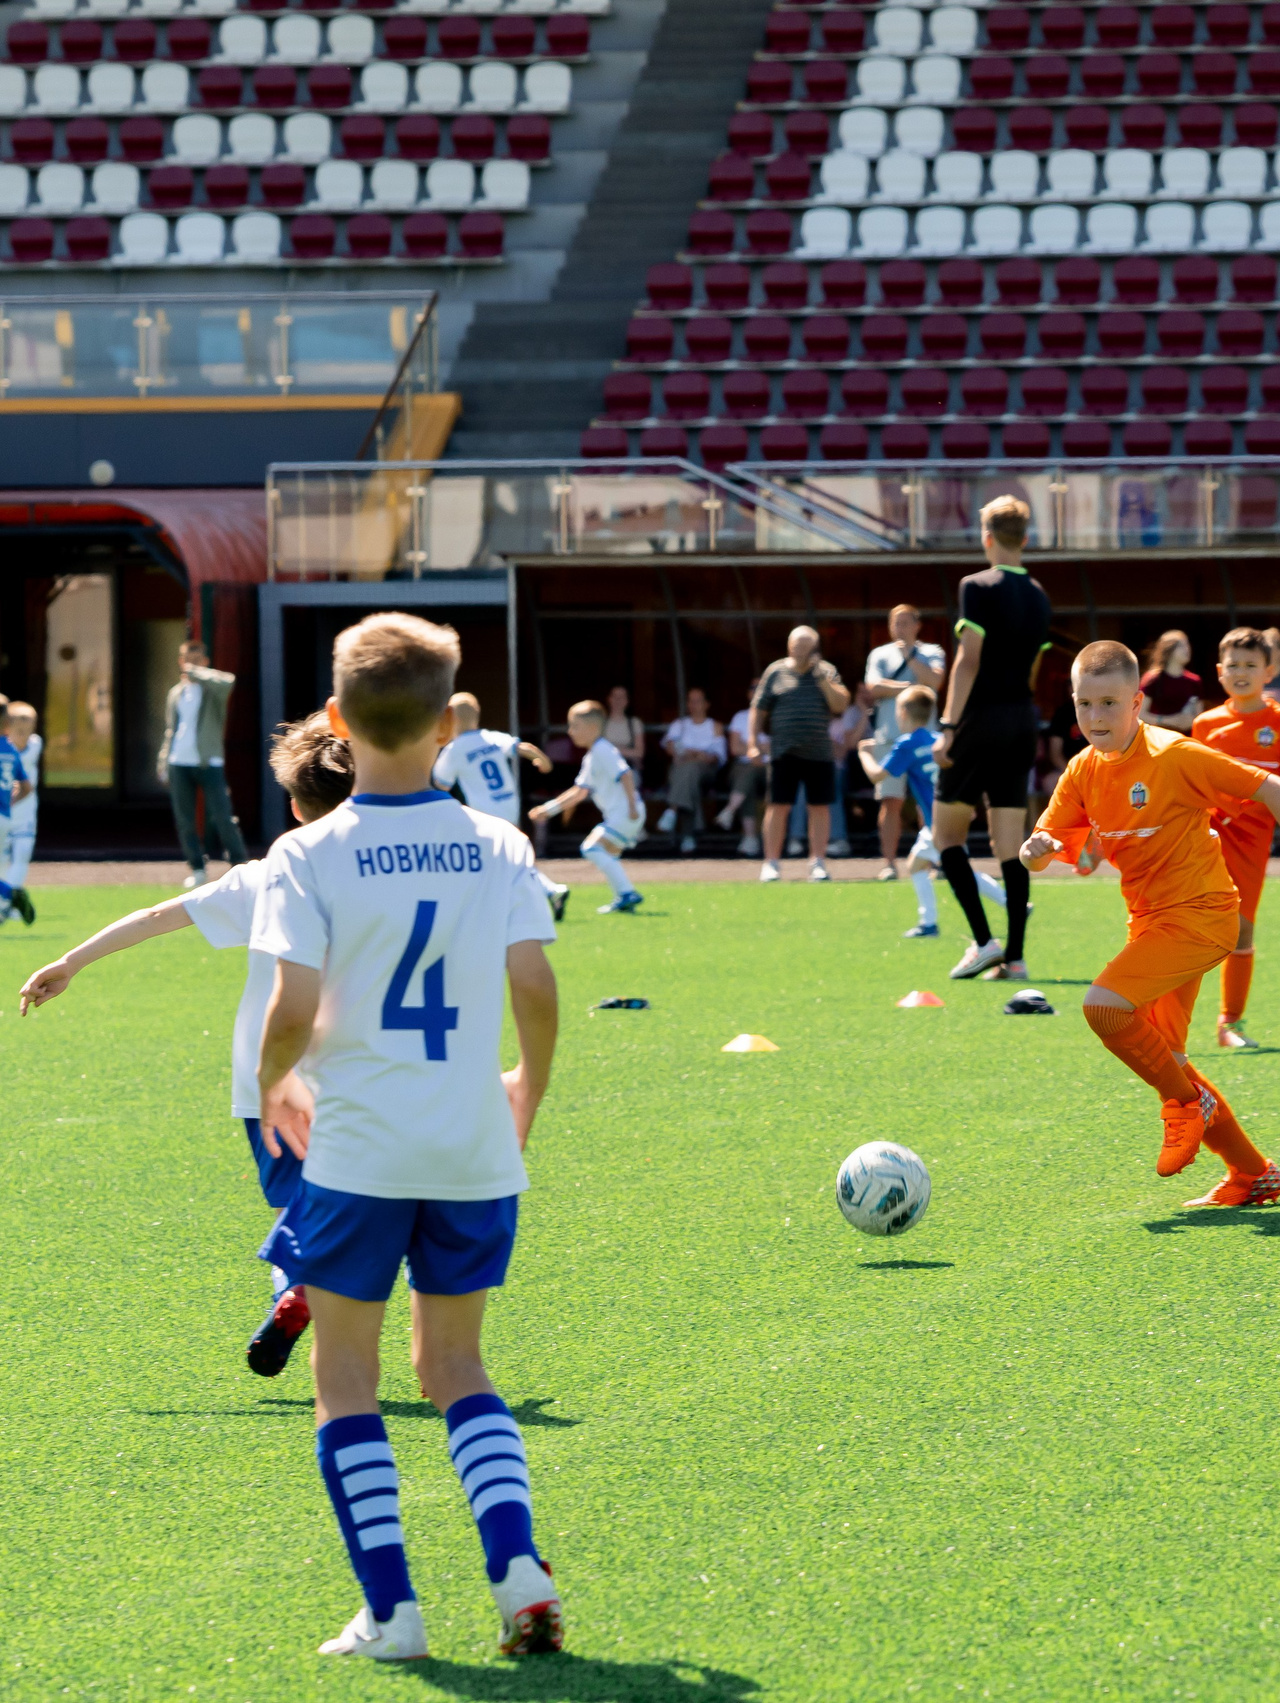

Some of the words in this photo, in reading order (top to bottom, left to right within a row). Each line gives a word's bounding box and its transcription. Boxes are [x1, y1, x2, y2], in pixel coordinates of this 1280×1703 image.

[480, 760, 504, 790] 9
[355, 842, 483, 878] НОВИКОВ
[380, 899, 460, 1062] 4
